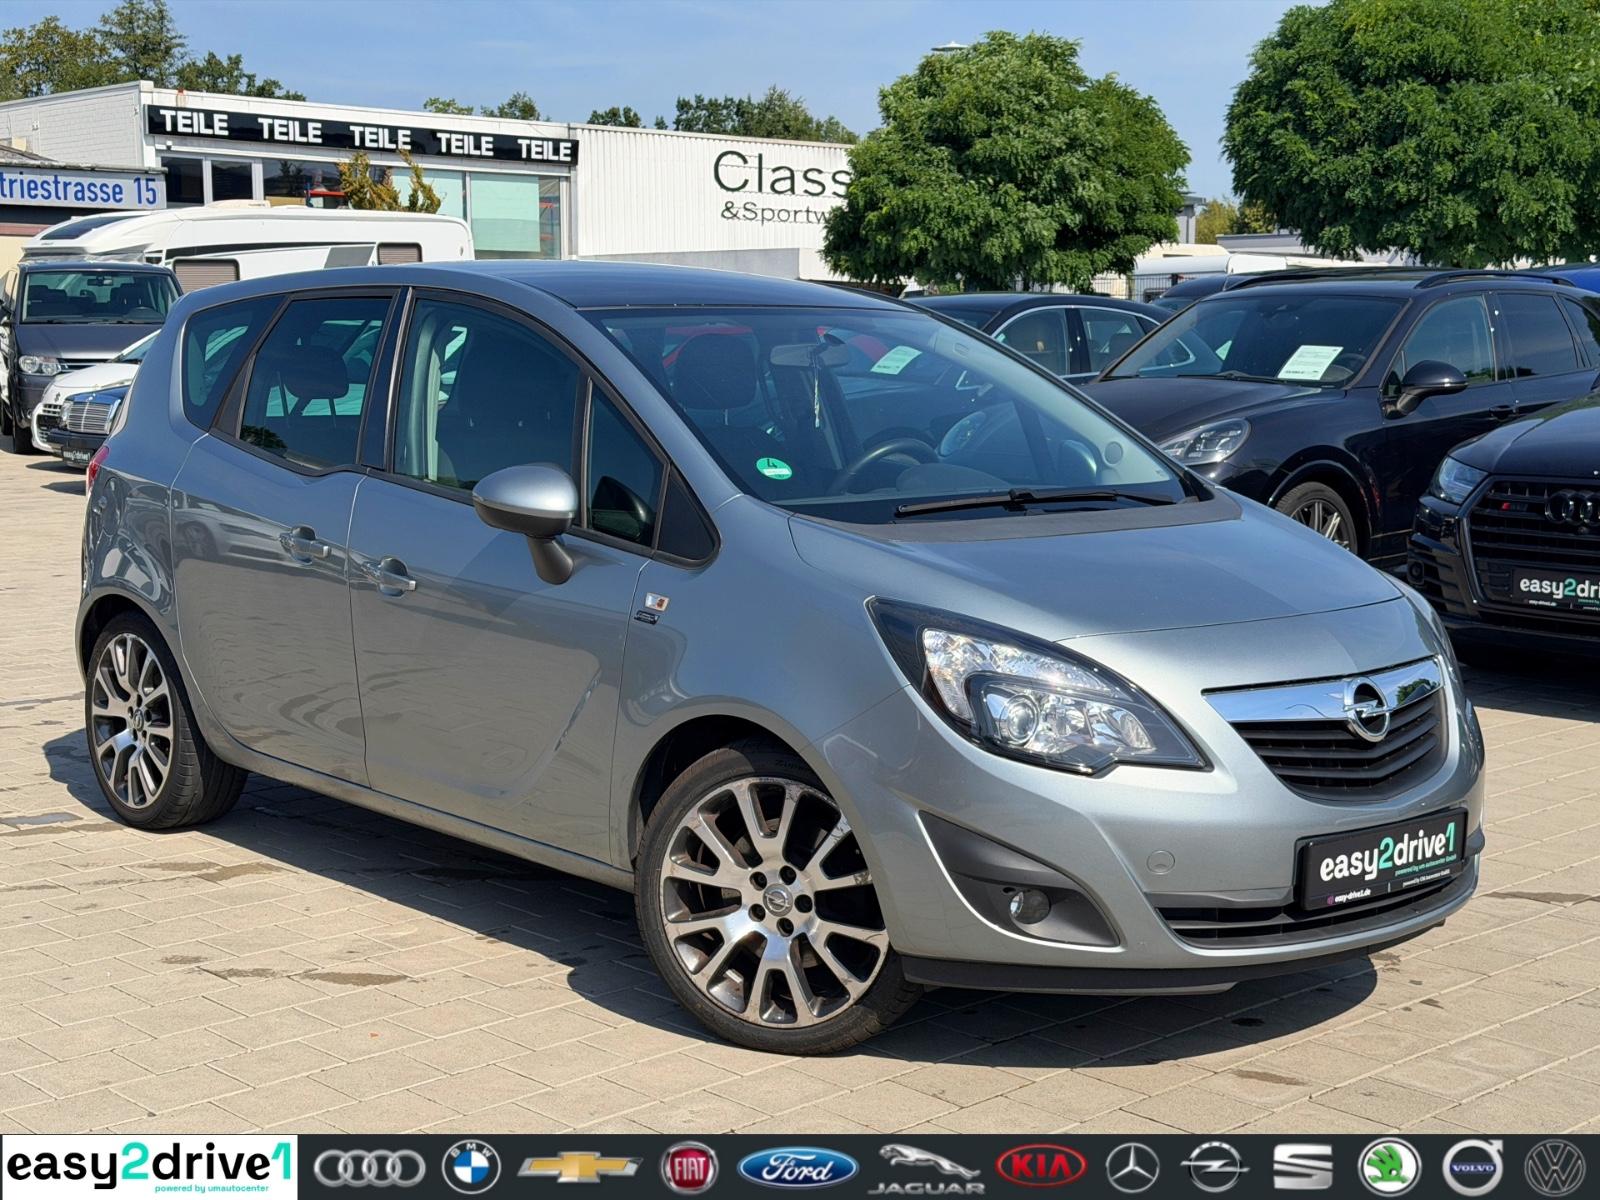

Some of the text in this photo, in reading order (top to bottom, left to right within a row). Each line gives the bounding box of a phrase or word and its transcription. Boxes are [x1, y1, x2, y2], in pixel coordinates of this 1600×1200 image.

[159, 109, 572, 161] TEILE TEILE TEILE TEILE TEILE
[0, 171, 157, 205] triestrasse 15
[713, 150, 851, 200] Class
[1320, 822, 1456, 881] easy2drive1
